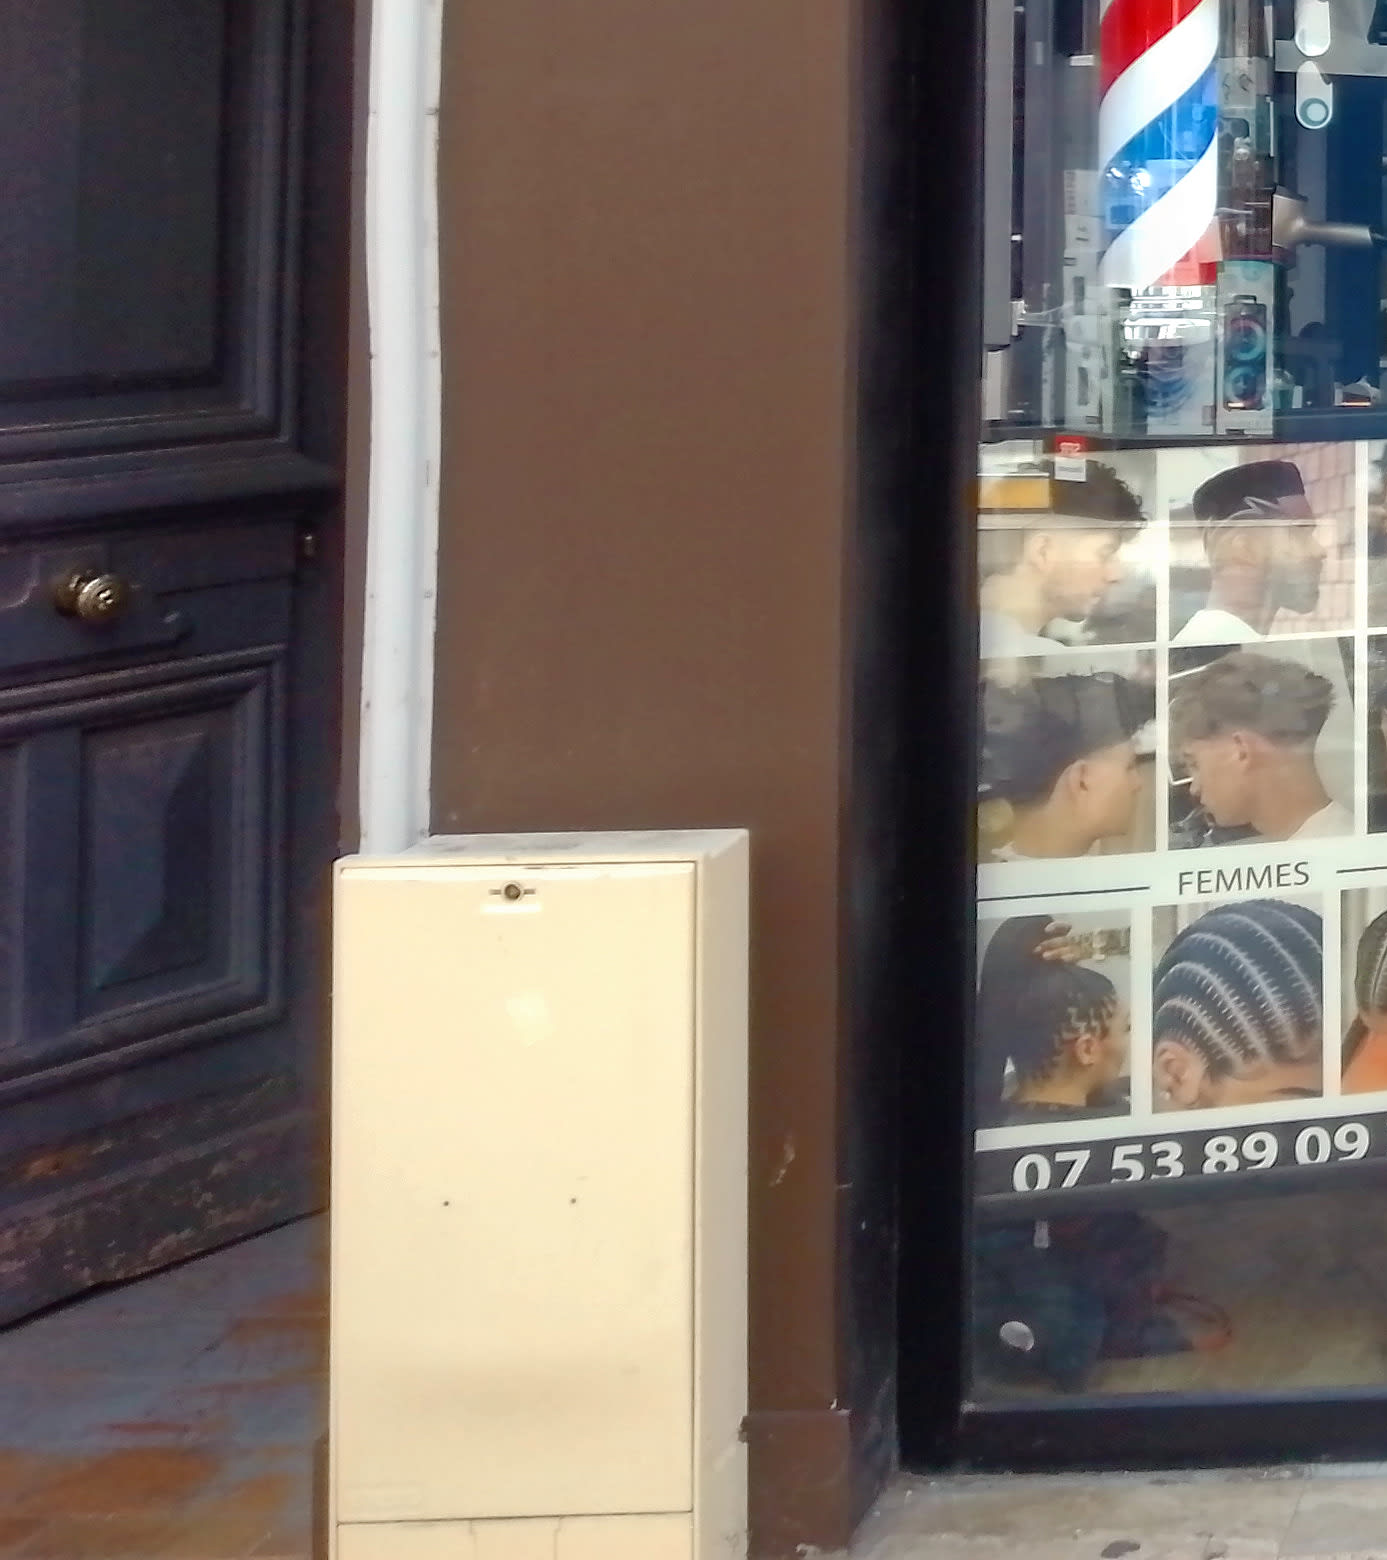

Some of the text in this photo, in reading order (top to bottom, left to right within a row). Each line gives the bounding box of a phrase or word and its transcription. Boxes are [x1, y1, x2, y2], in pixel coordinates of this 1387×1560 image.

[1178, 861, 1310, 895] FEMMES
[1011, 1149, 1092, 1194] 07
[1110, 1140, 1185, 1185] 53
[1201, 1131, 1279, 1175] 89
[1294, 1122, 1371, 1168] 09
